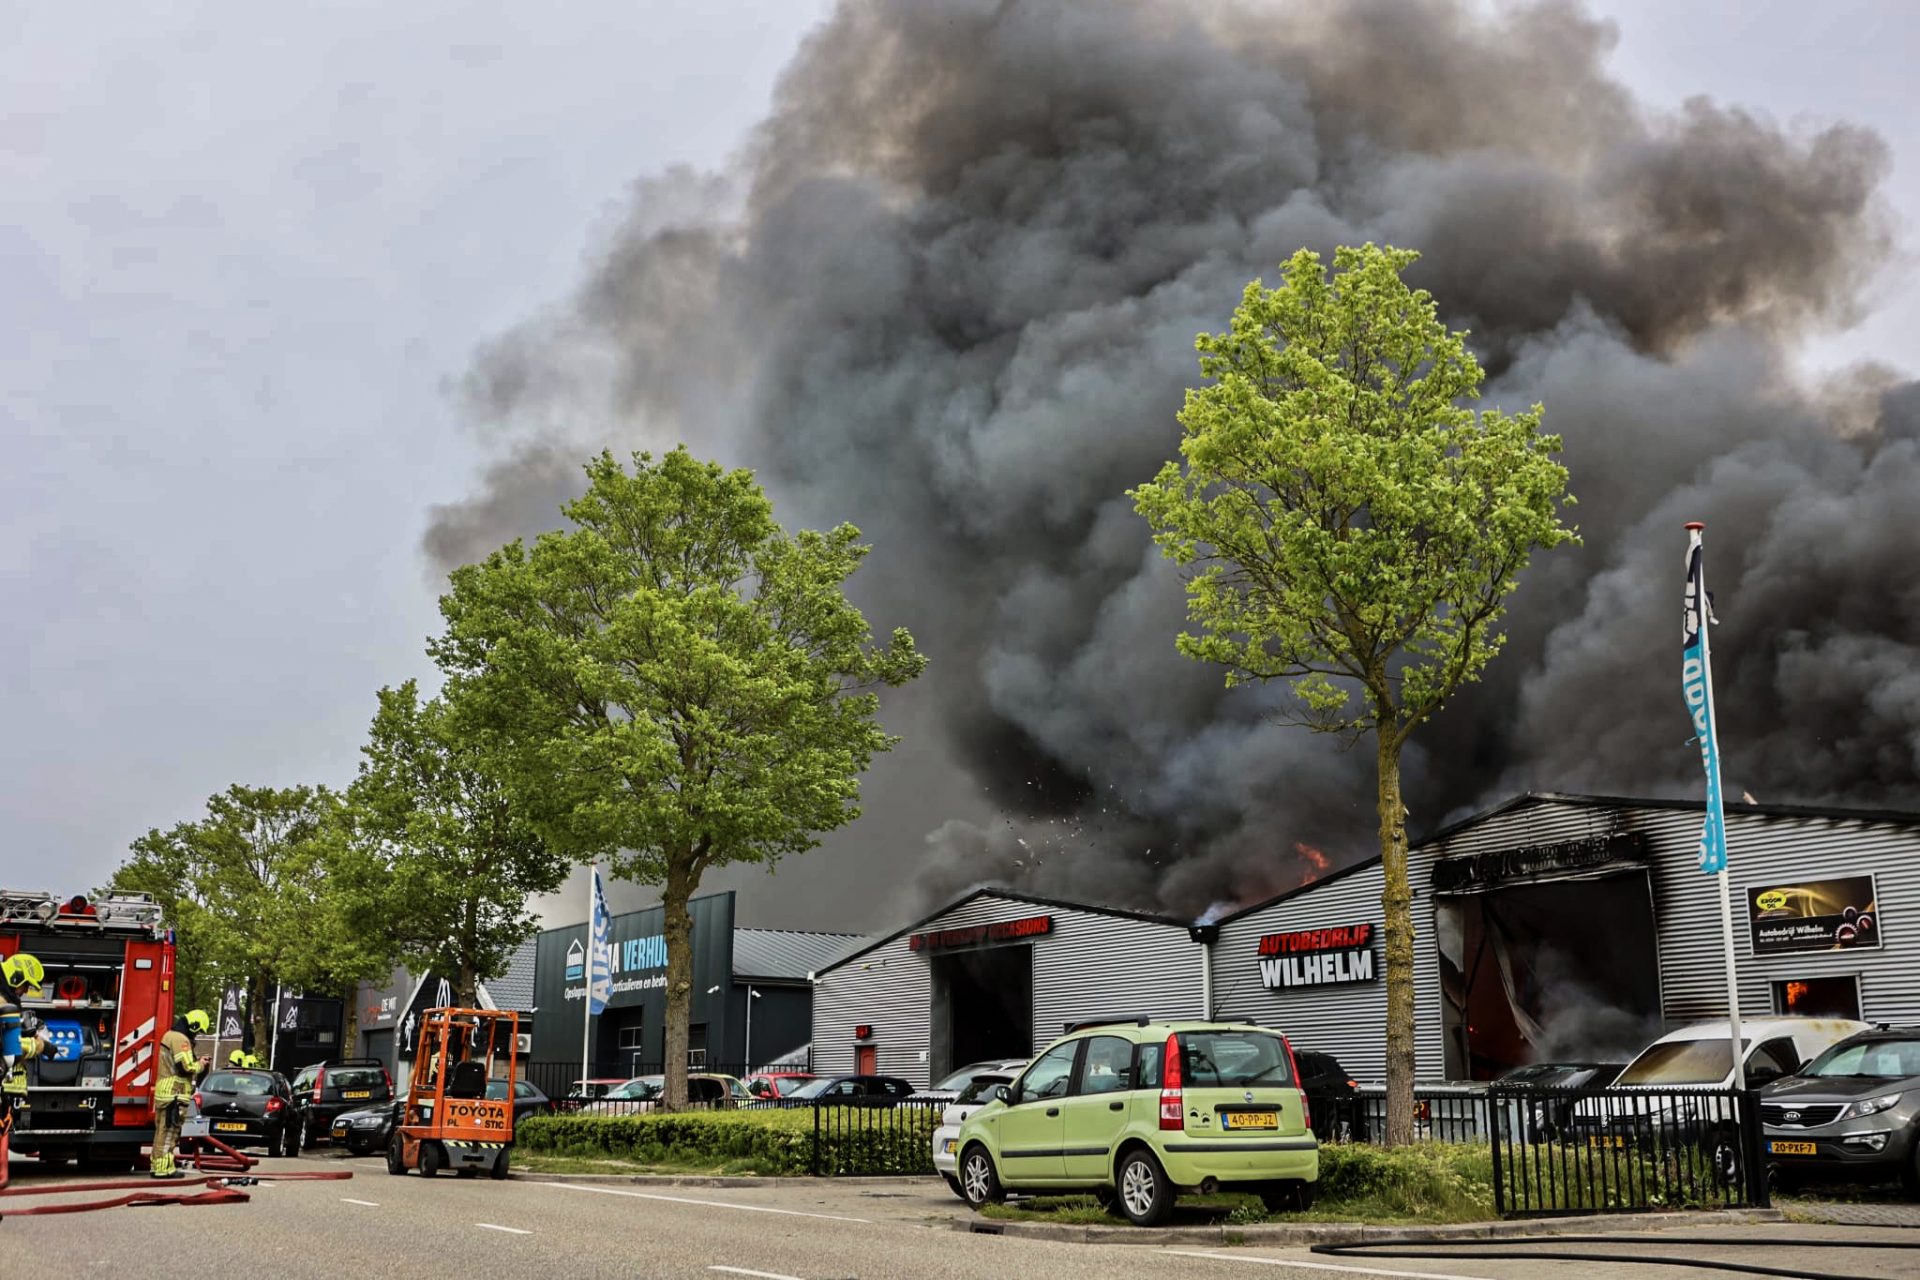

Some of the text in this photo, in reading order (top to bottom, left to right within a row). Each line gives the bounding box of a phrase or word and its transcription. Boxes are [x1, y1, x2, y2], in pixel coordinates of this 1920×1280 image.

[1759, 926, 1795, 937] Autobedrijf
[1796, 924, 1824, 934] Wilhelm
[1259, 925, 1370, 955] AUTOBEDRIJF
[1259, 949, 1373, 988] WILHELM
[449, 1104, 505, 1118] TOYOTA
[484, 1119, 505, 1130] STIC
[1231, 1114, 1275, 1126] 40-PP-JZ
[1773, 1142, 1813, 1153] 20-PXF-7
